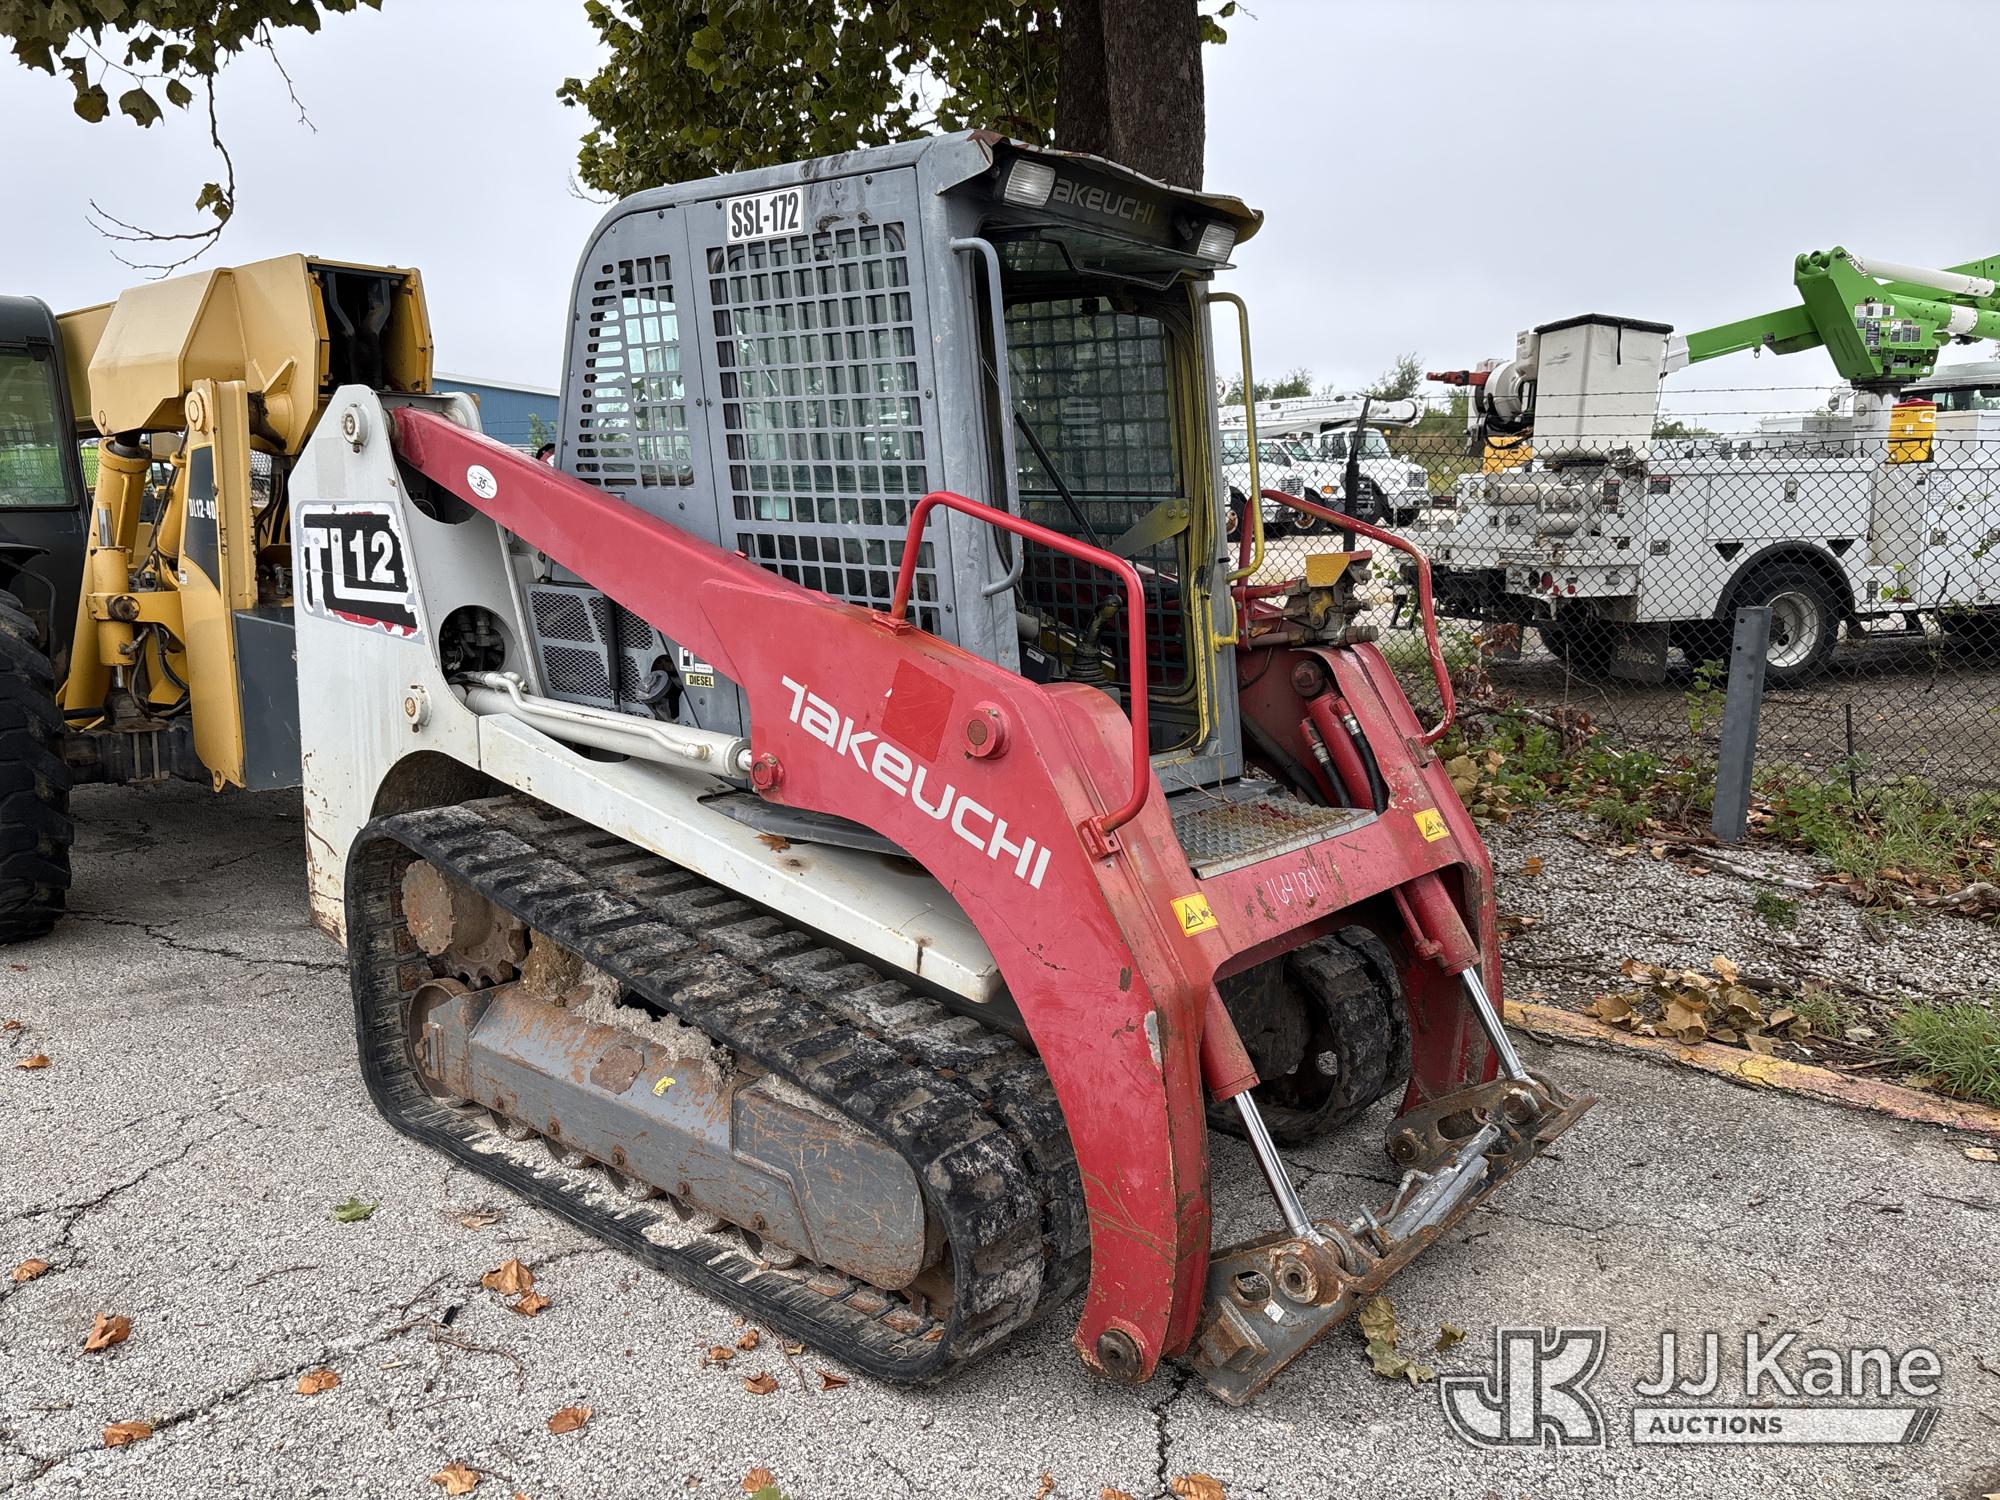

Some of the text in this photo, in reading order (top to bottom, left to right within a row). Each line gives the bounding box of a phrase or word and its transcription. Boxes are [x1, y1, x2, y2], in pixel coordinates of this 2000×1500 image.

[731, 191, 799, 238] SSL-172
[477, 476, 487, 489] 35
[301, 527, 408, 612] TL12
[689, 674, 714, 687] DIESEL
